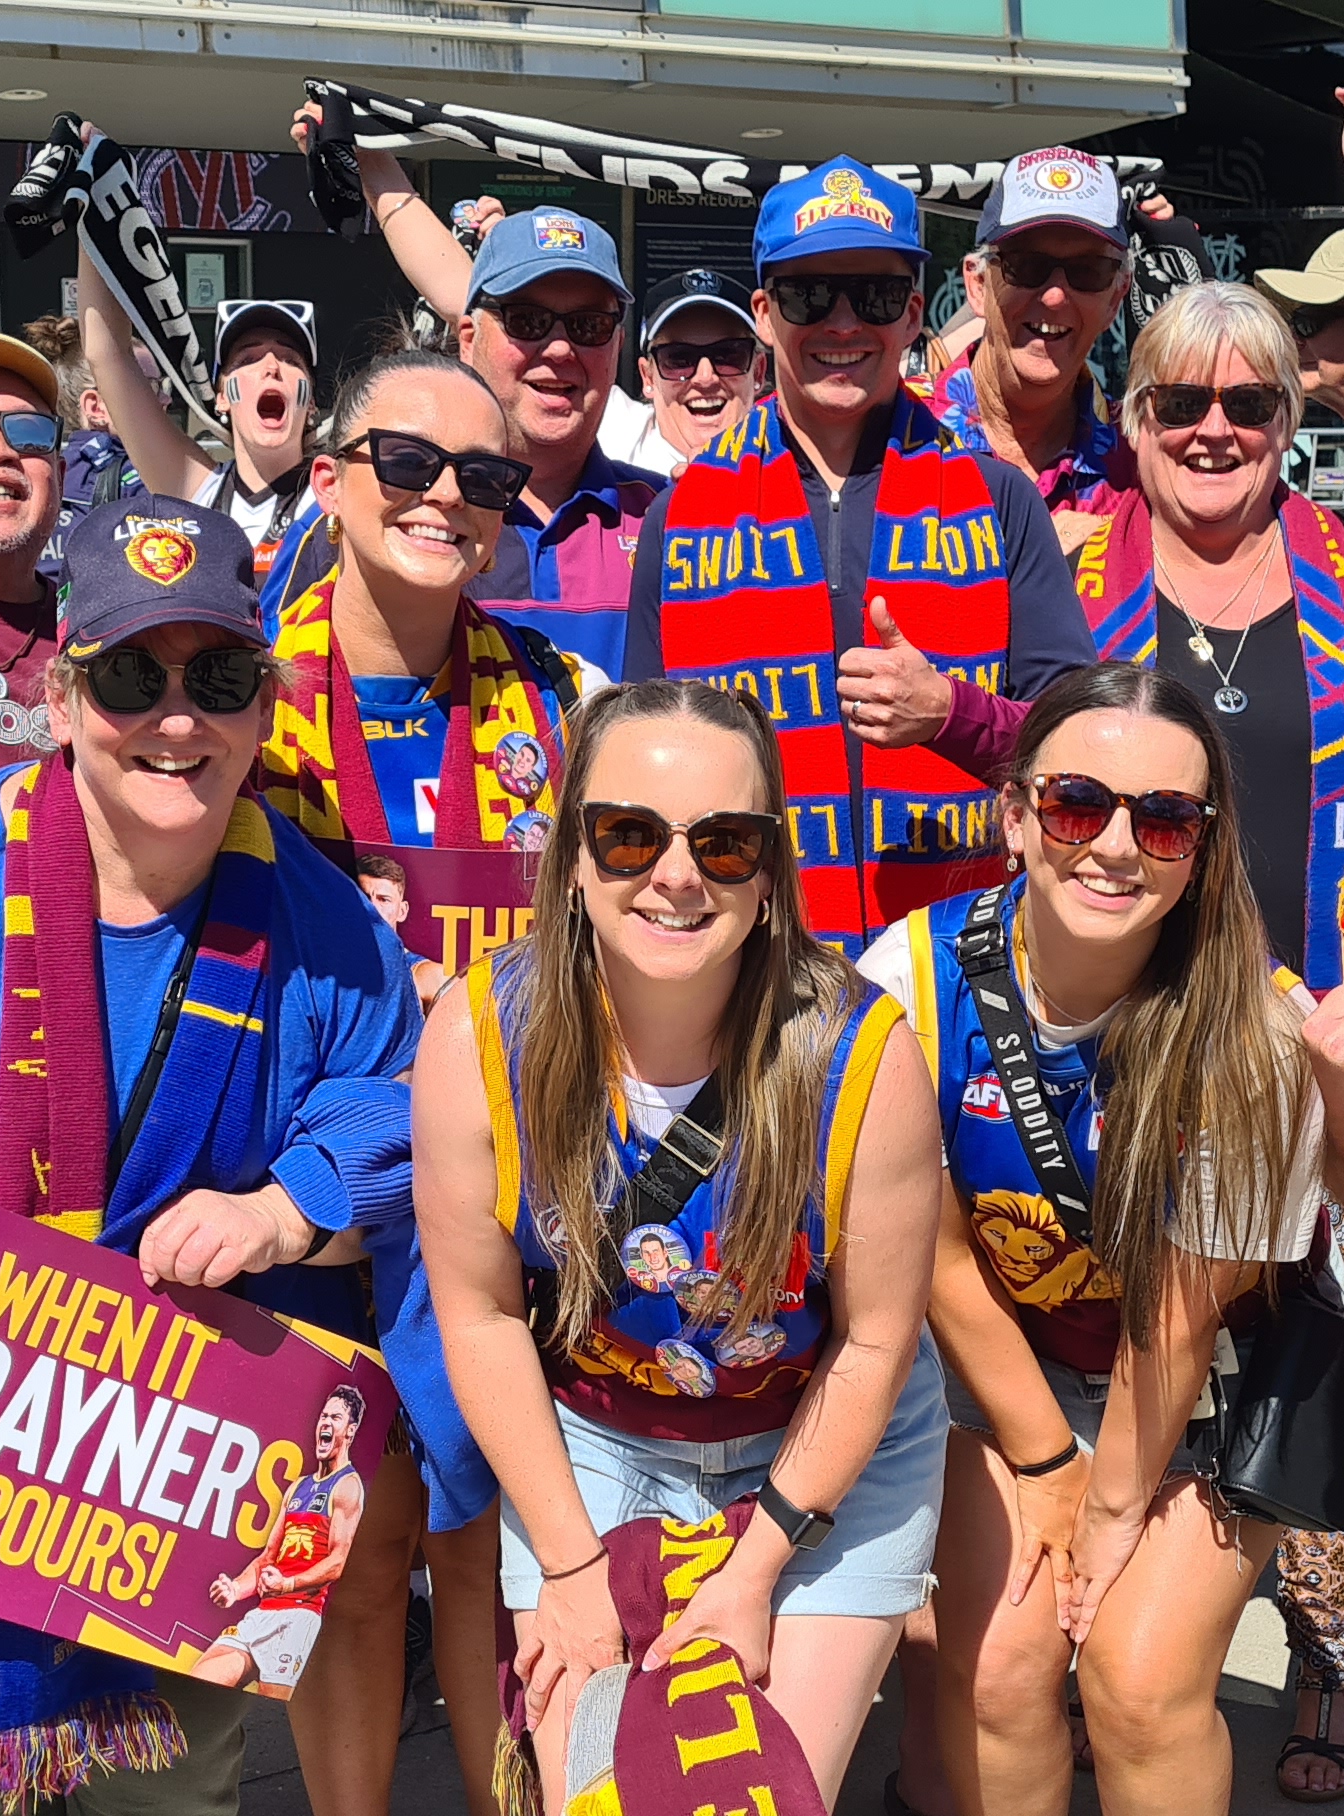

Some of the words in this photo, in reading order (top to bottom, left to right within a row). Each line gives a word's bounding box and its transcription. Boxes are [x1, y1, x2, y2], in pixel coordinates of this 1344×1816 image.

[1017, 148, 1103, 177] BRISBANE
[646, 188, 696, 207] DRESS
[1019, 182, 1071, 200] FOOTBALL
[1076, 185, 1099, 200] CLUB
[795, 202, 894, 236] FITZROY
[114, 519, 202, 541] LIONS
[358, 718, 430, 741] BLK
[996, 1032, 1067, 1171] ST.ODDITY
[148, 1319, 222, 1400] IT
